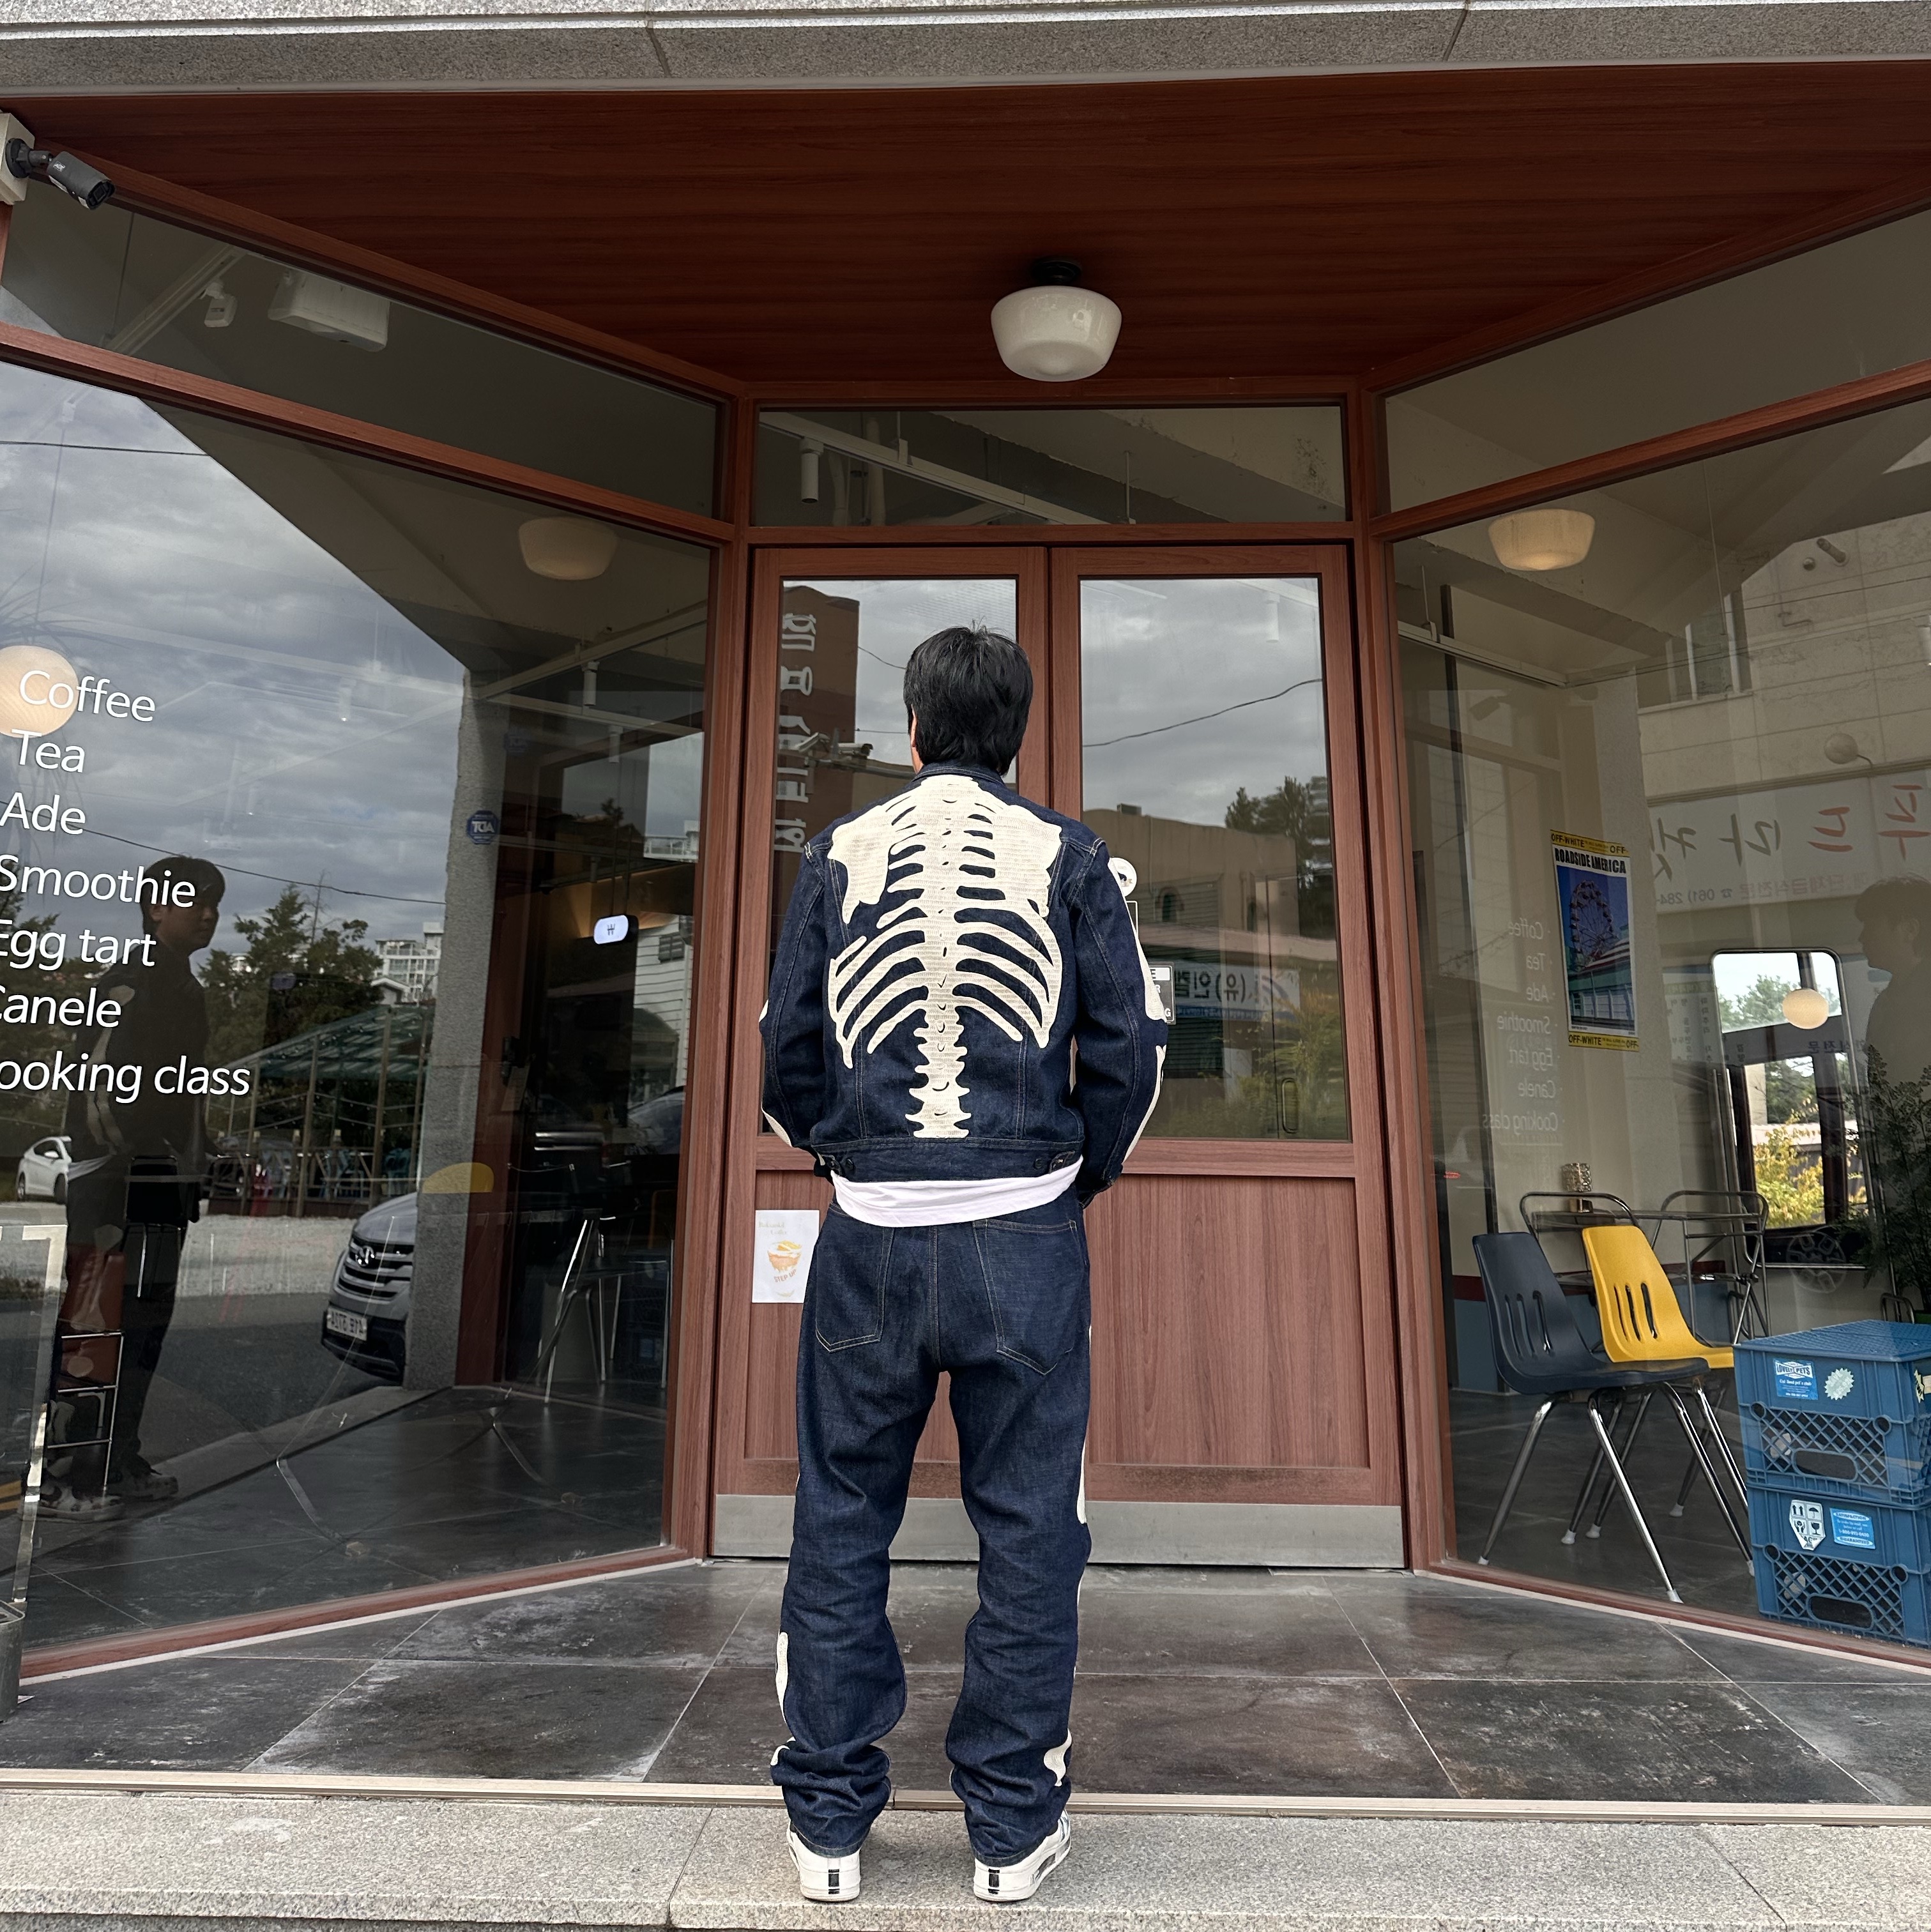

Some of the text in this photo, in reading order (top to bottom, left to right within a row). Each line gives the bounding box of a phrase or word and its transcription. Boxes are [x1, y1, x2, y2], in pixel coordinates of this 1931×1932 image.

[19, 669, 156, 723] Coffee
[11, 728, 86, 773] Tea
[0, 792, 86, 835] Ade
[1551, 833, 1585, 848] OFF-WHITE
[0, 854, 196, 908] Smoothie
[1555, 848, 1626, 874] ROADSIDE AMERICA
[79, 929, 157, 967] tart
[0, 985, 122, 1028] anele
[1568, 1034, 1602, 1046] OFF-WHITE
[0, 1051, 251, 1104] ooking class
[774, 1268, 797, 1283] STEP UP
[1776, 1364, 1793, 1373] LOVELY
[1796, 1367, 1810, 1375] PETS
